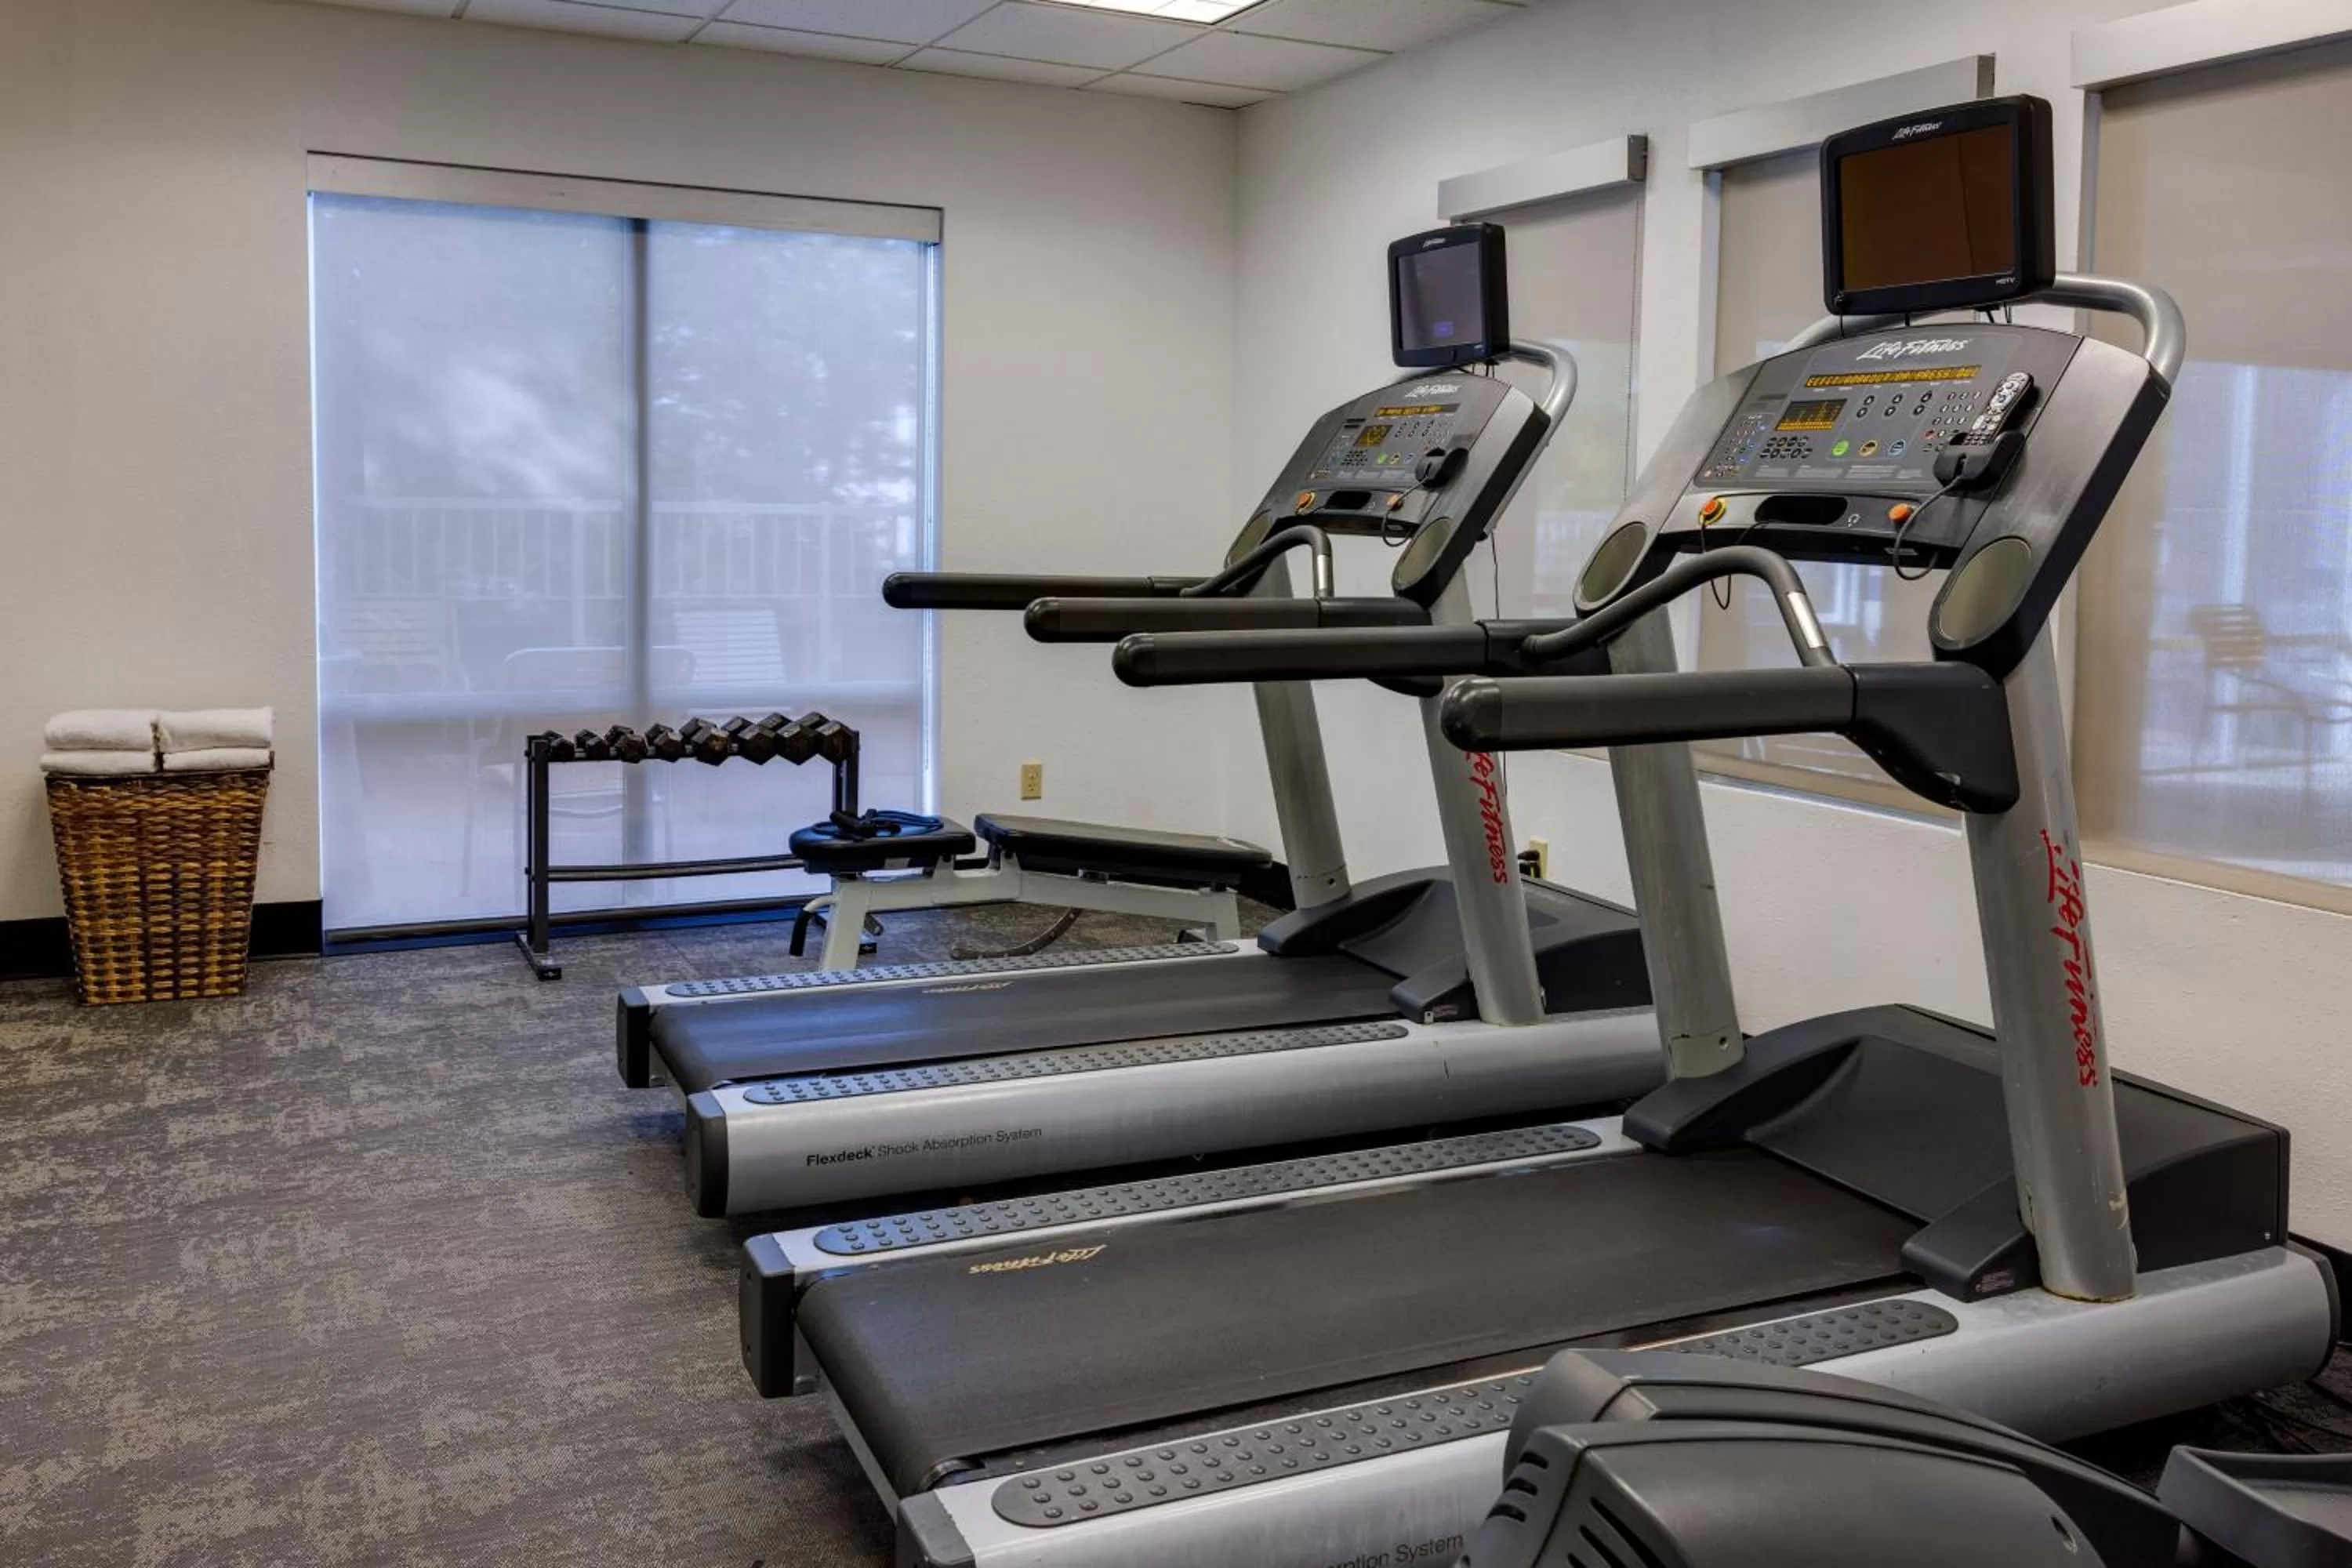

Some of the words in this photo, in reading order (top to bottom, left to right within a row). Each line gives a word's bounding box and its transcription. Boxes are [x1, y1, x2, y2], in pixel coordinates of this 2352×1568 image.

[806, 1148, 873, 1167] Flexdeck
[877, 1139, 919, 1158] Shock
[923, 1132, 993, 1152] Absorption
[996, 1127, 1043, 1143] System
[1395, 1534, 1465, 1563] System
